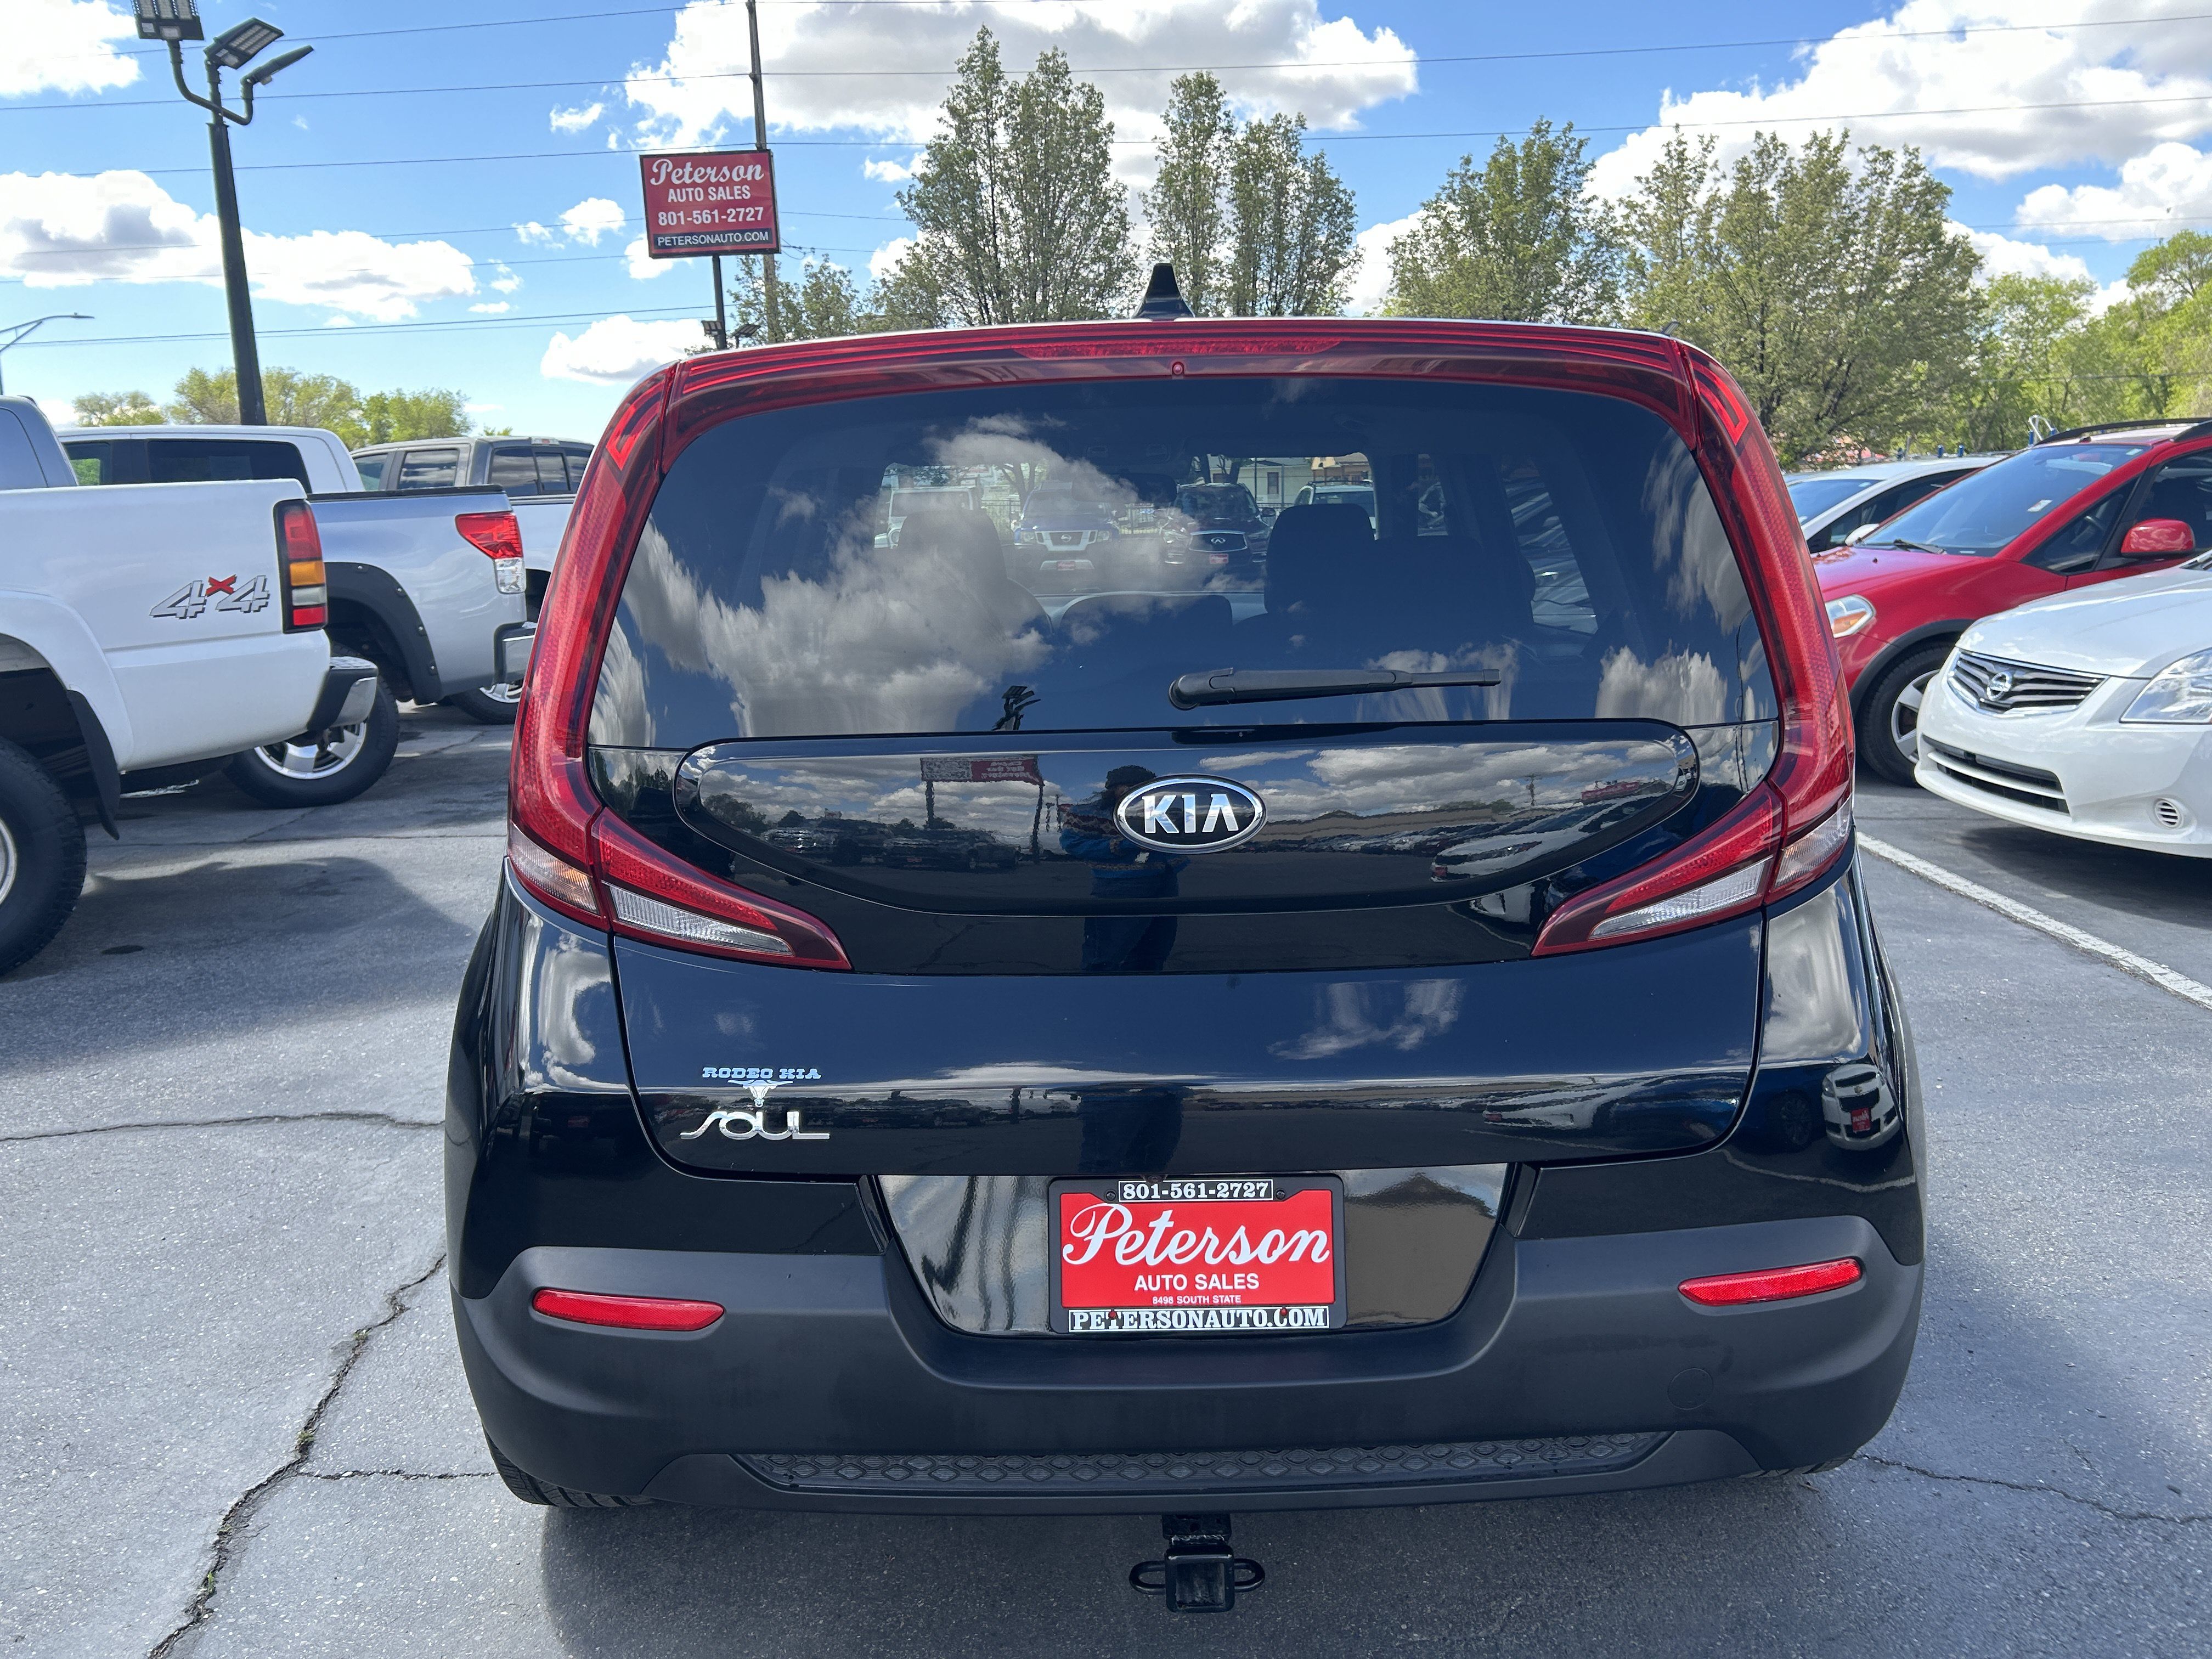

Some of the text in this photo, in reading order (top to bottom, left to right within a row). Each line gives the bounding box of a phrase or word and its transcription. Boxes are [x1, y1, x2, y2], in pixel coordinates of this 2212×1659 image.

[650, 159, 764, 185] Peterson
[668, 185, 751, 202] AUTO SALES
[658, 207, 764, 226] 801-561-2727
[657, 231, 769, 246] PETERSONAUTO.COM
[1142, 793, 1239, 833] KIA
[702, 1067, 821, 1079] RODEO KIA
[1123, 1182, 1269, 1200] 801-561-2727
[1062, 1203, 1330, 1266] Peterson
[1134, 1273, 1260, 1291] AUTO SALES
[1152, 1295, 1242, 1305] 8498 SOUTH STATE
[1073, 1308, 1325, 1330] PETERSONAUTO.COM
